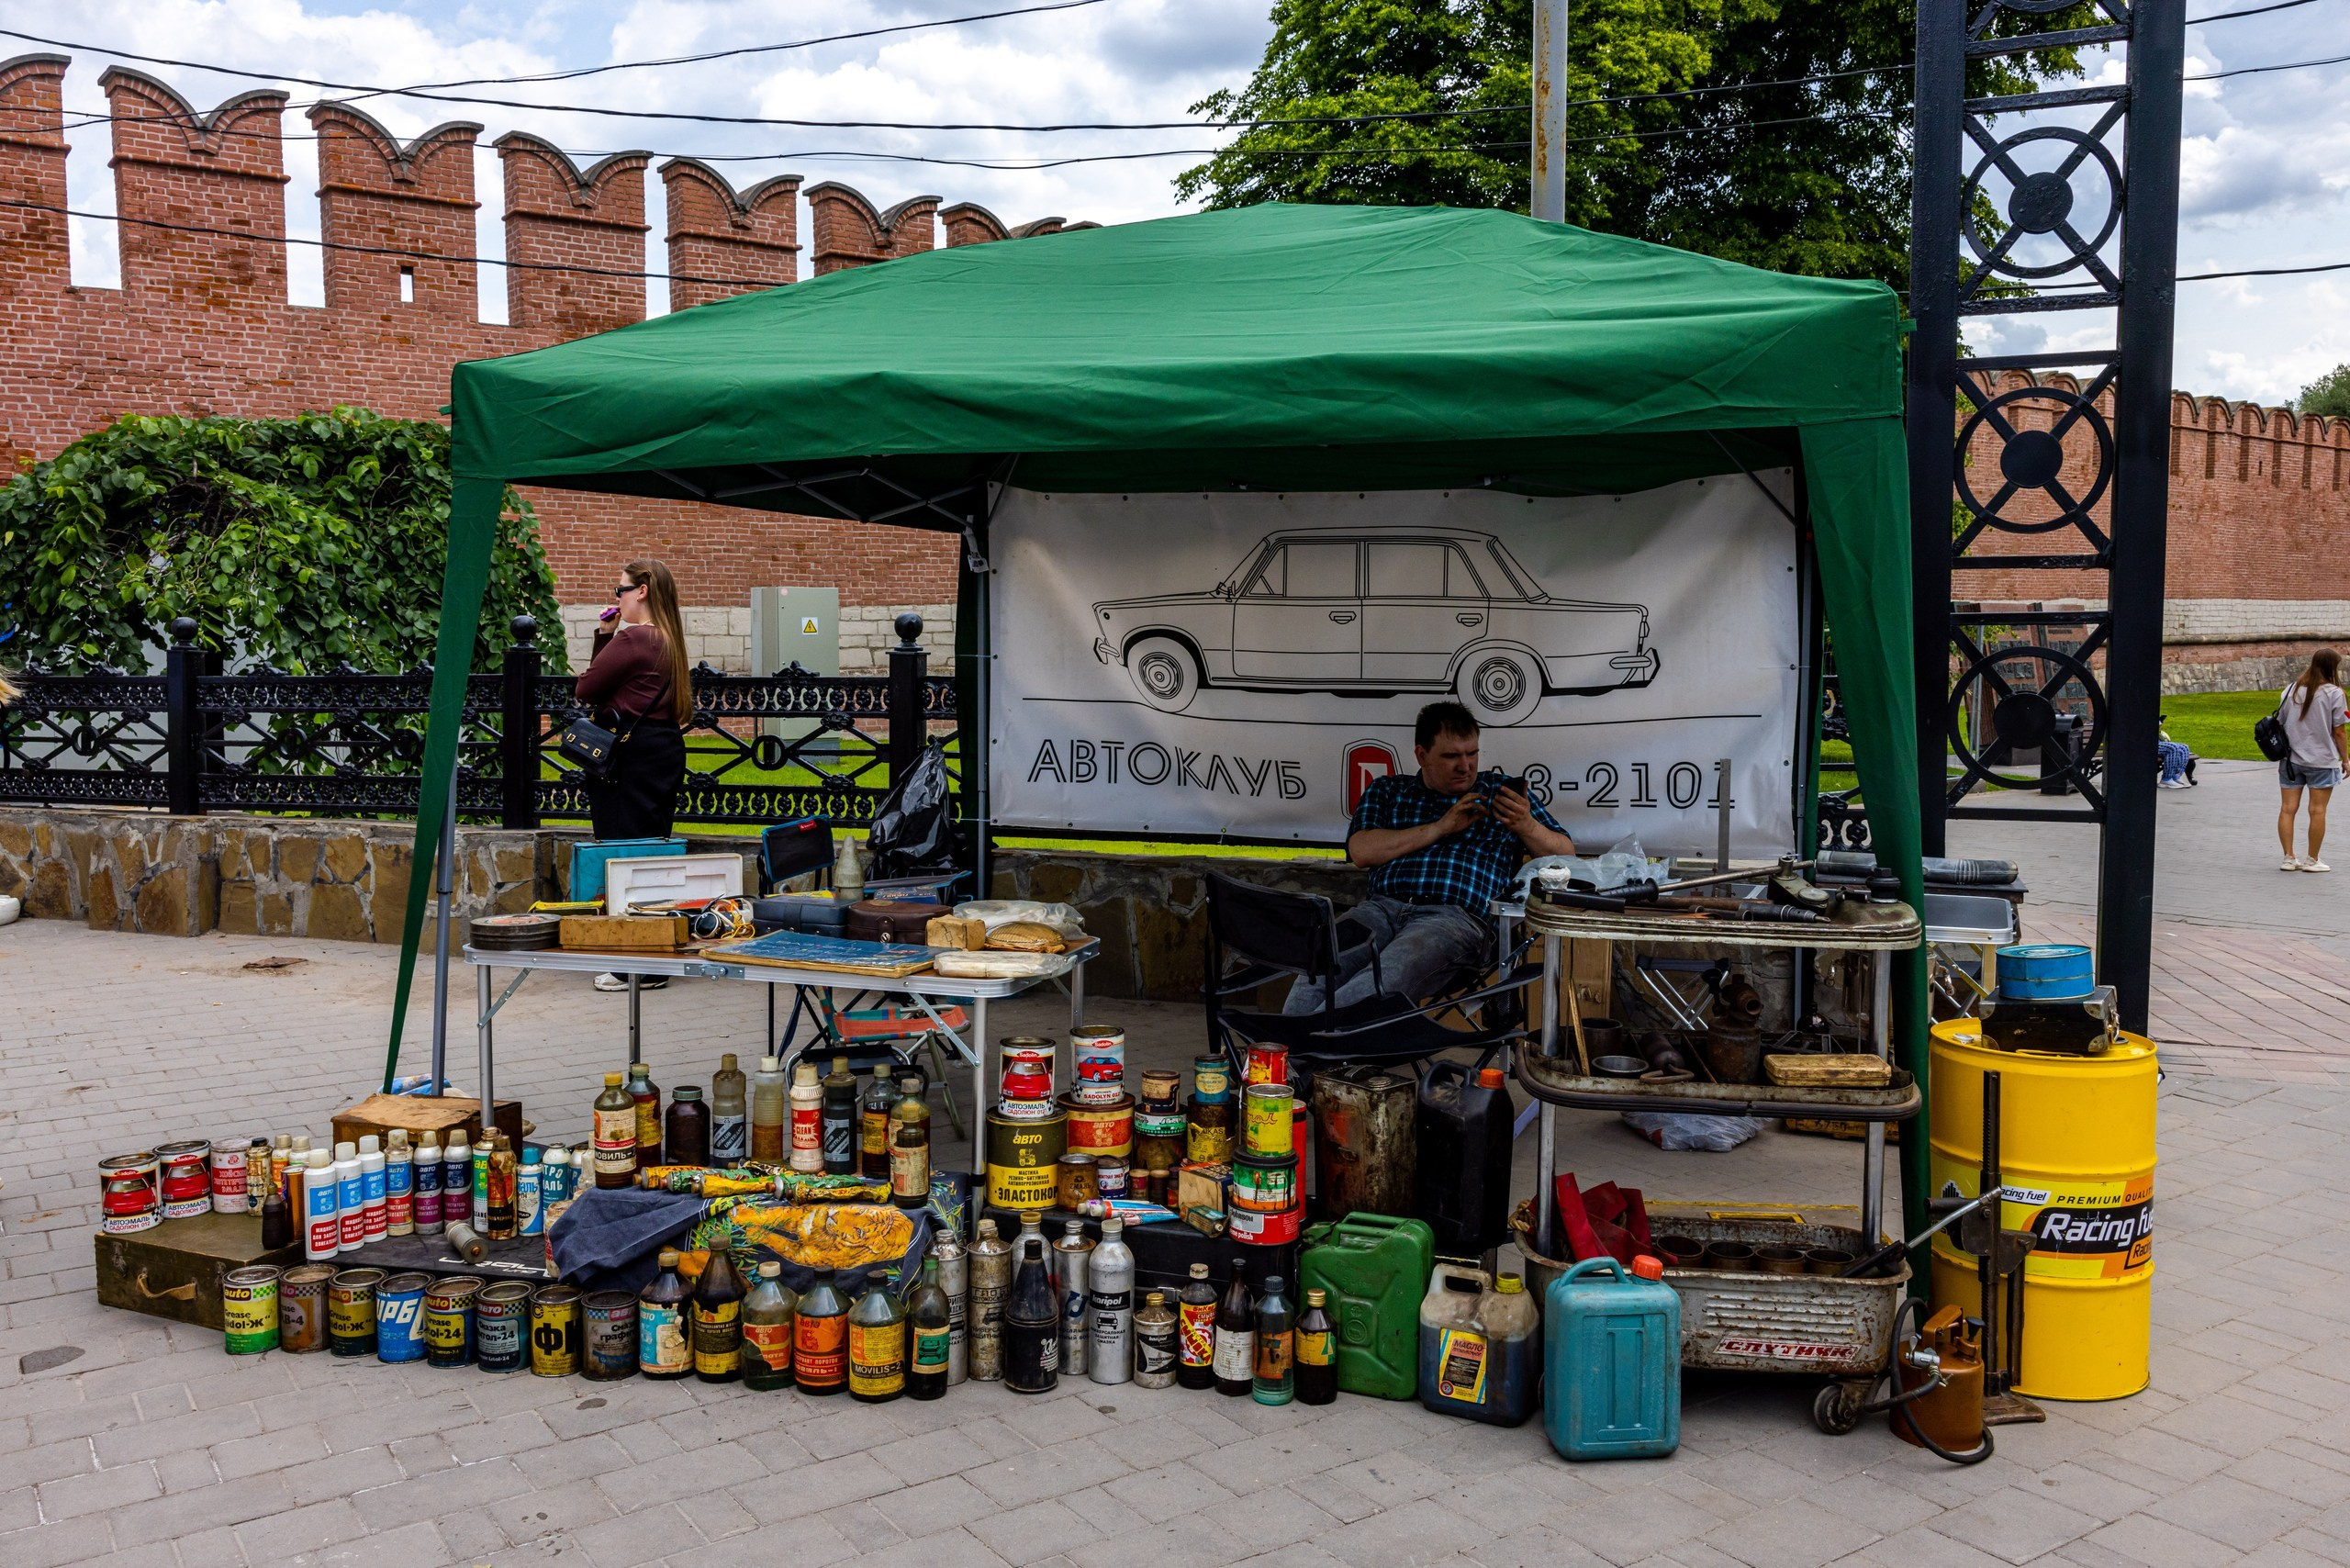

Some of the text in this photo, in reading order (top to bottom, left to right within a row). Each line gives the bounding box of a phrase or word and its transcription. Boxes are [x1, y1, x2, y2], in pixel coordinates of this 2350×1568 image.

[1026, 738, 1735, 810] АВТОКЛУБ З-2101
[796, 1126, 812, 1135] CLEAN
[1013, 1134, 1043, 1145] авто
[474, 1159, 487, 1170] ав
[368, 1173, 384, 1182] авто
[543, 1180, 564, 1192] АЛЬ
[317, 1188, 334, 1196] авто
[998, 1186, 1058, 1203] ЭЛАСТОКОР
[2000, 1188, 2047, 1202] acing fuel
[2056, 1186, 2154, 1205] PREMIUM QUALIT
[168, 1200, 207, 1211] АВТОЭМАЛЬ
[109, 1216, 151, 1226] АВТОЭМАЛЬ
[2040, 1205, 2154, 1248] Racing fue
[2132, 1239, 2153, 1260] Racin
[224, 1288, 251, 1299] auto
[330, 1291, 350, 1300] auto
[428, 1297, 449, 1307] auto
[477, 1304, 502, 1315] авто
[610, 1322, 632, 1332] Смаз
[1453, 1339, 1483, 1352] МАСЛО
[1724, 1340, 1854, 1358] СПУТНИК
[855, 1361, 901, 1375] MOVILIS-2
